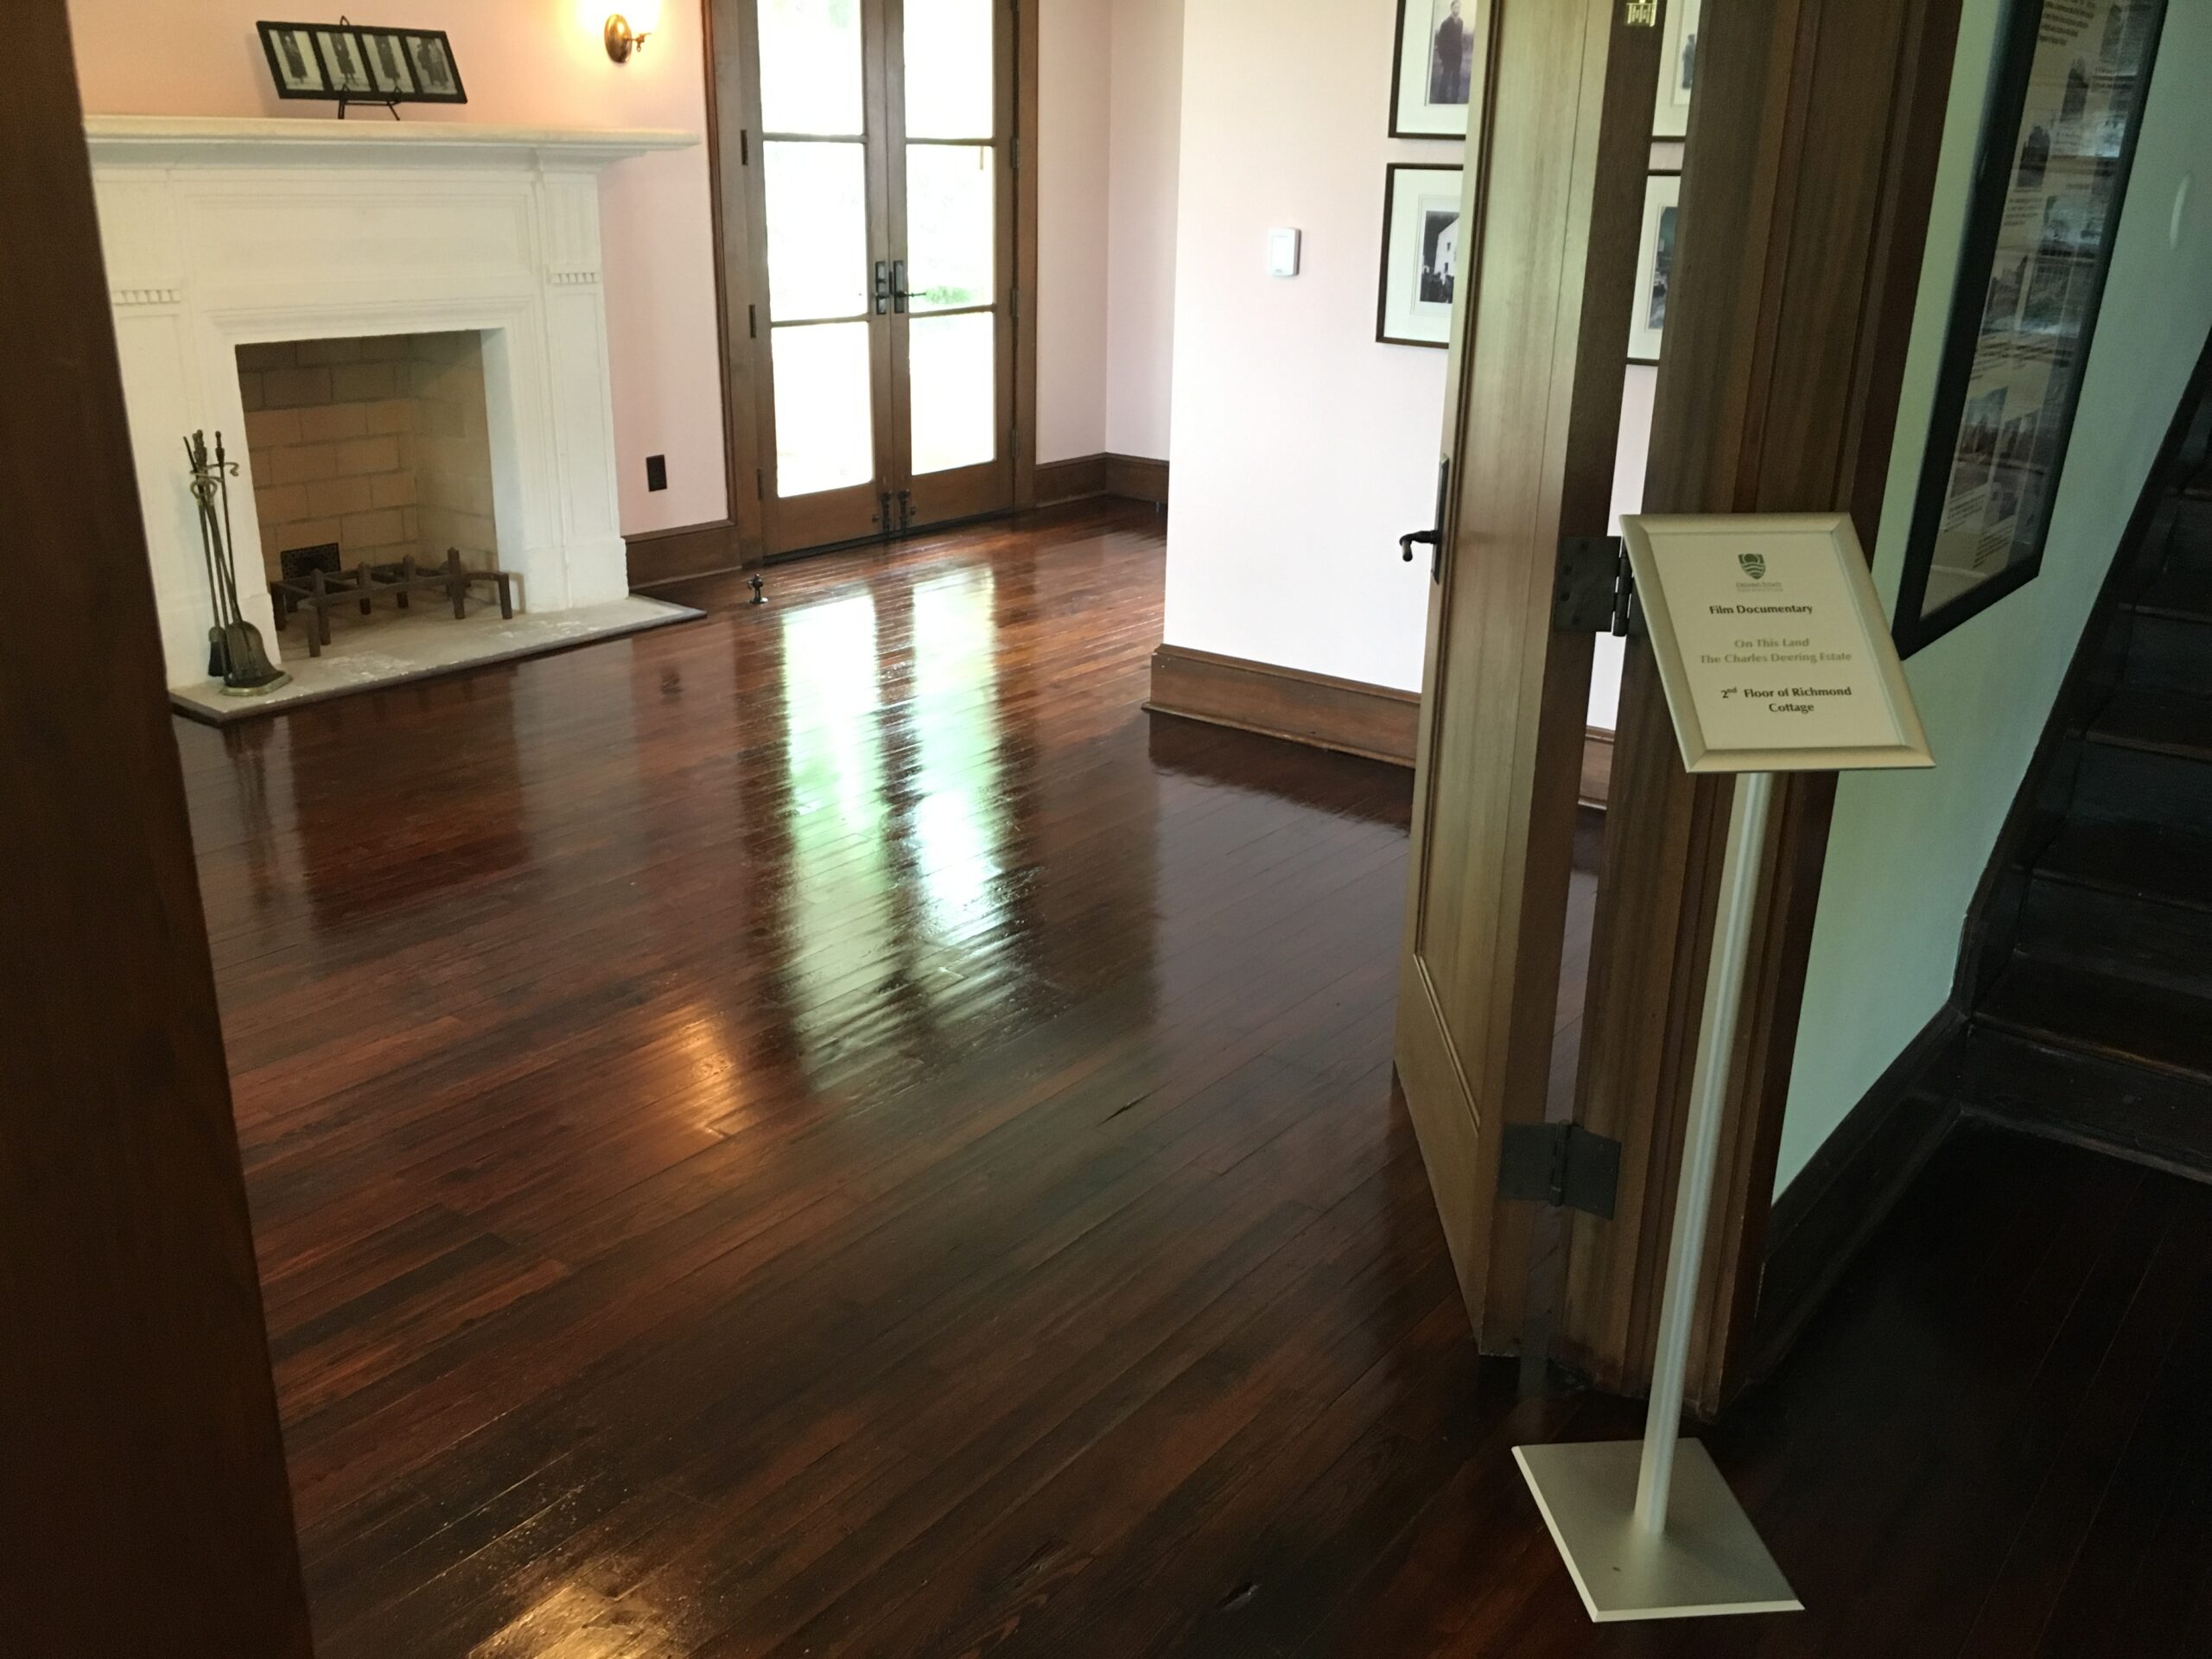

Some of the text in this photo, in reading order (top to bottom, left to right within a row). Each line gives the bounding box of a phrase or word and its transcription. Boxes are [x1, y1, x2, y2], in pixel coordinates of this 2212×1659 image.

[1709, 605, 1813, 614] Film Documentary
[1757, 638, 1779, 647] This
[1783, 637, 1809, 647] Land
[1700, 652, 1852, 664] The Charles Deering Estate
[1720, 687, 1853, 699] 2nd Floor of Richmond
[1769, 702, 1815, 713] Cottage
